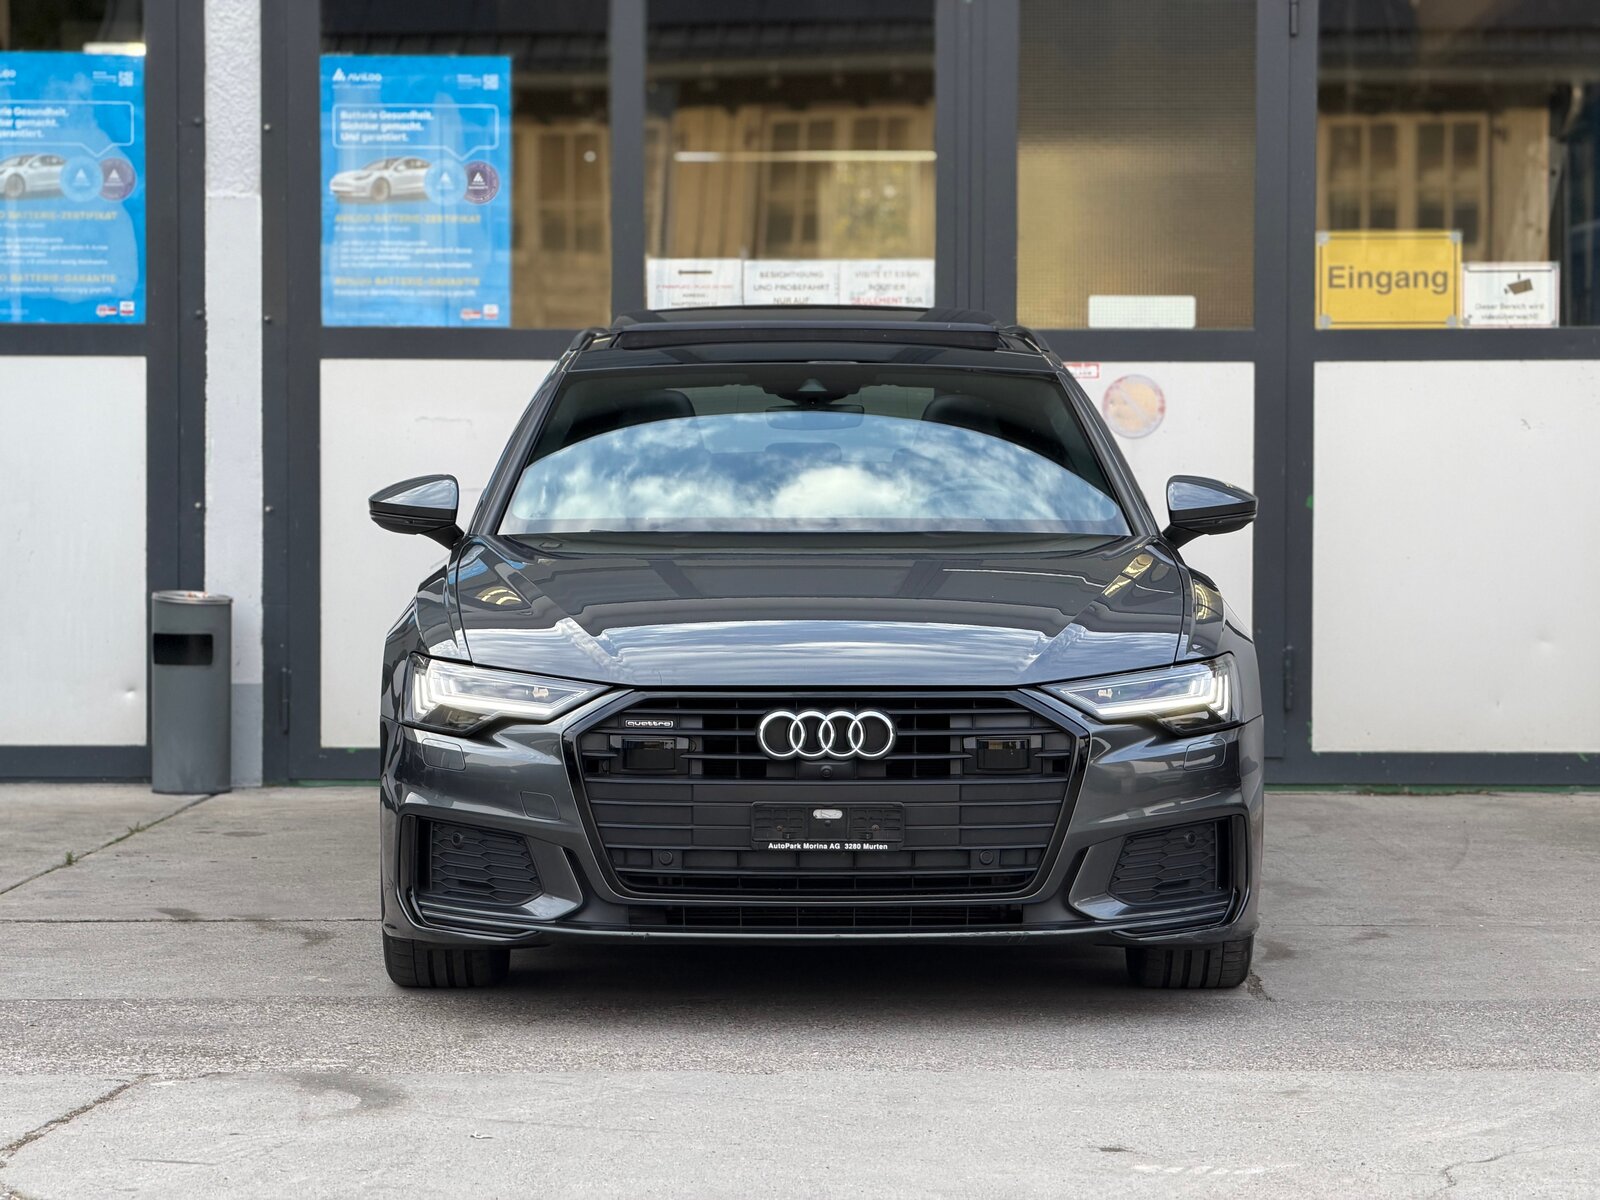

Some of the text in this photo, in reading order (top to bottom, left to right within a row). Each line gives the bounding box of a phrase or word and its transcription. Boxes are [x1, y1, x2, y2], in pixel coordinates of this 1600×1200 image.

[1328, 265, 1449, 295] Eingang
[768, 842, 801, 850] AutoPark
[803, 842, 828, 850] Morina
